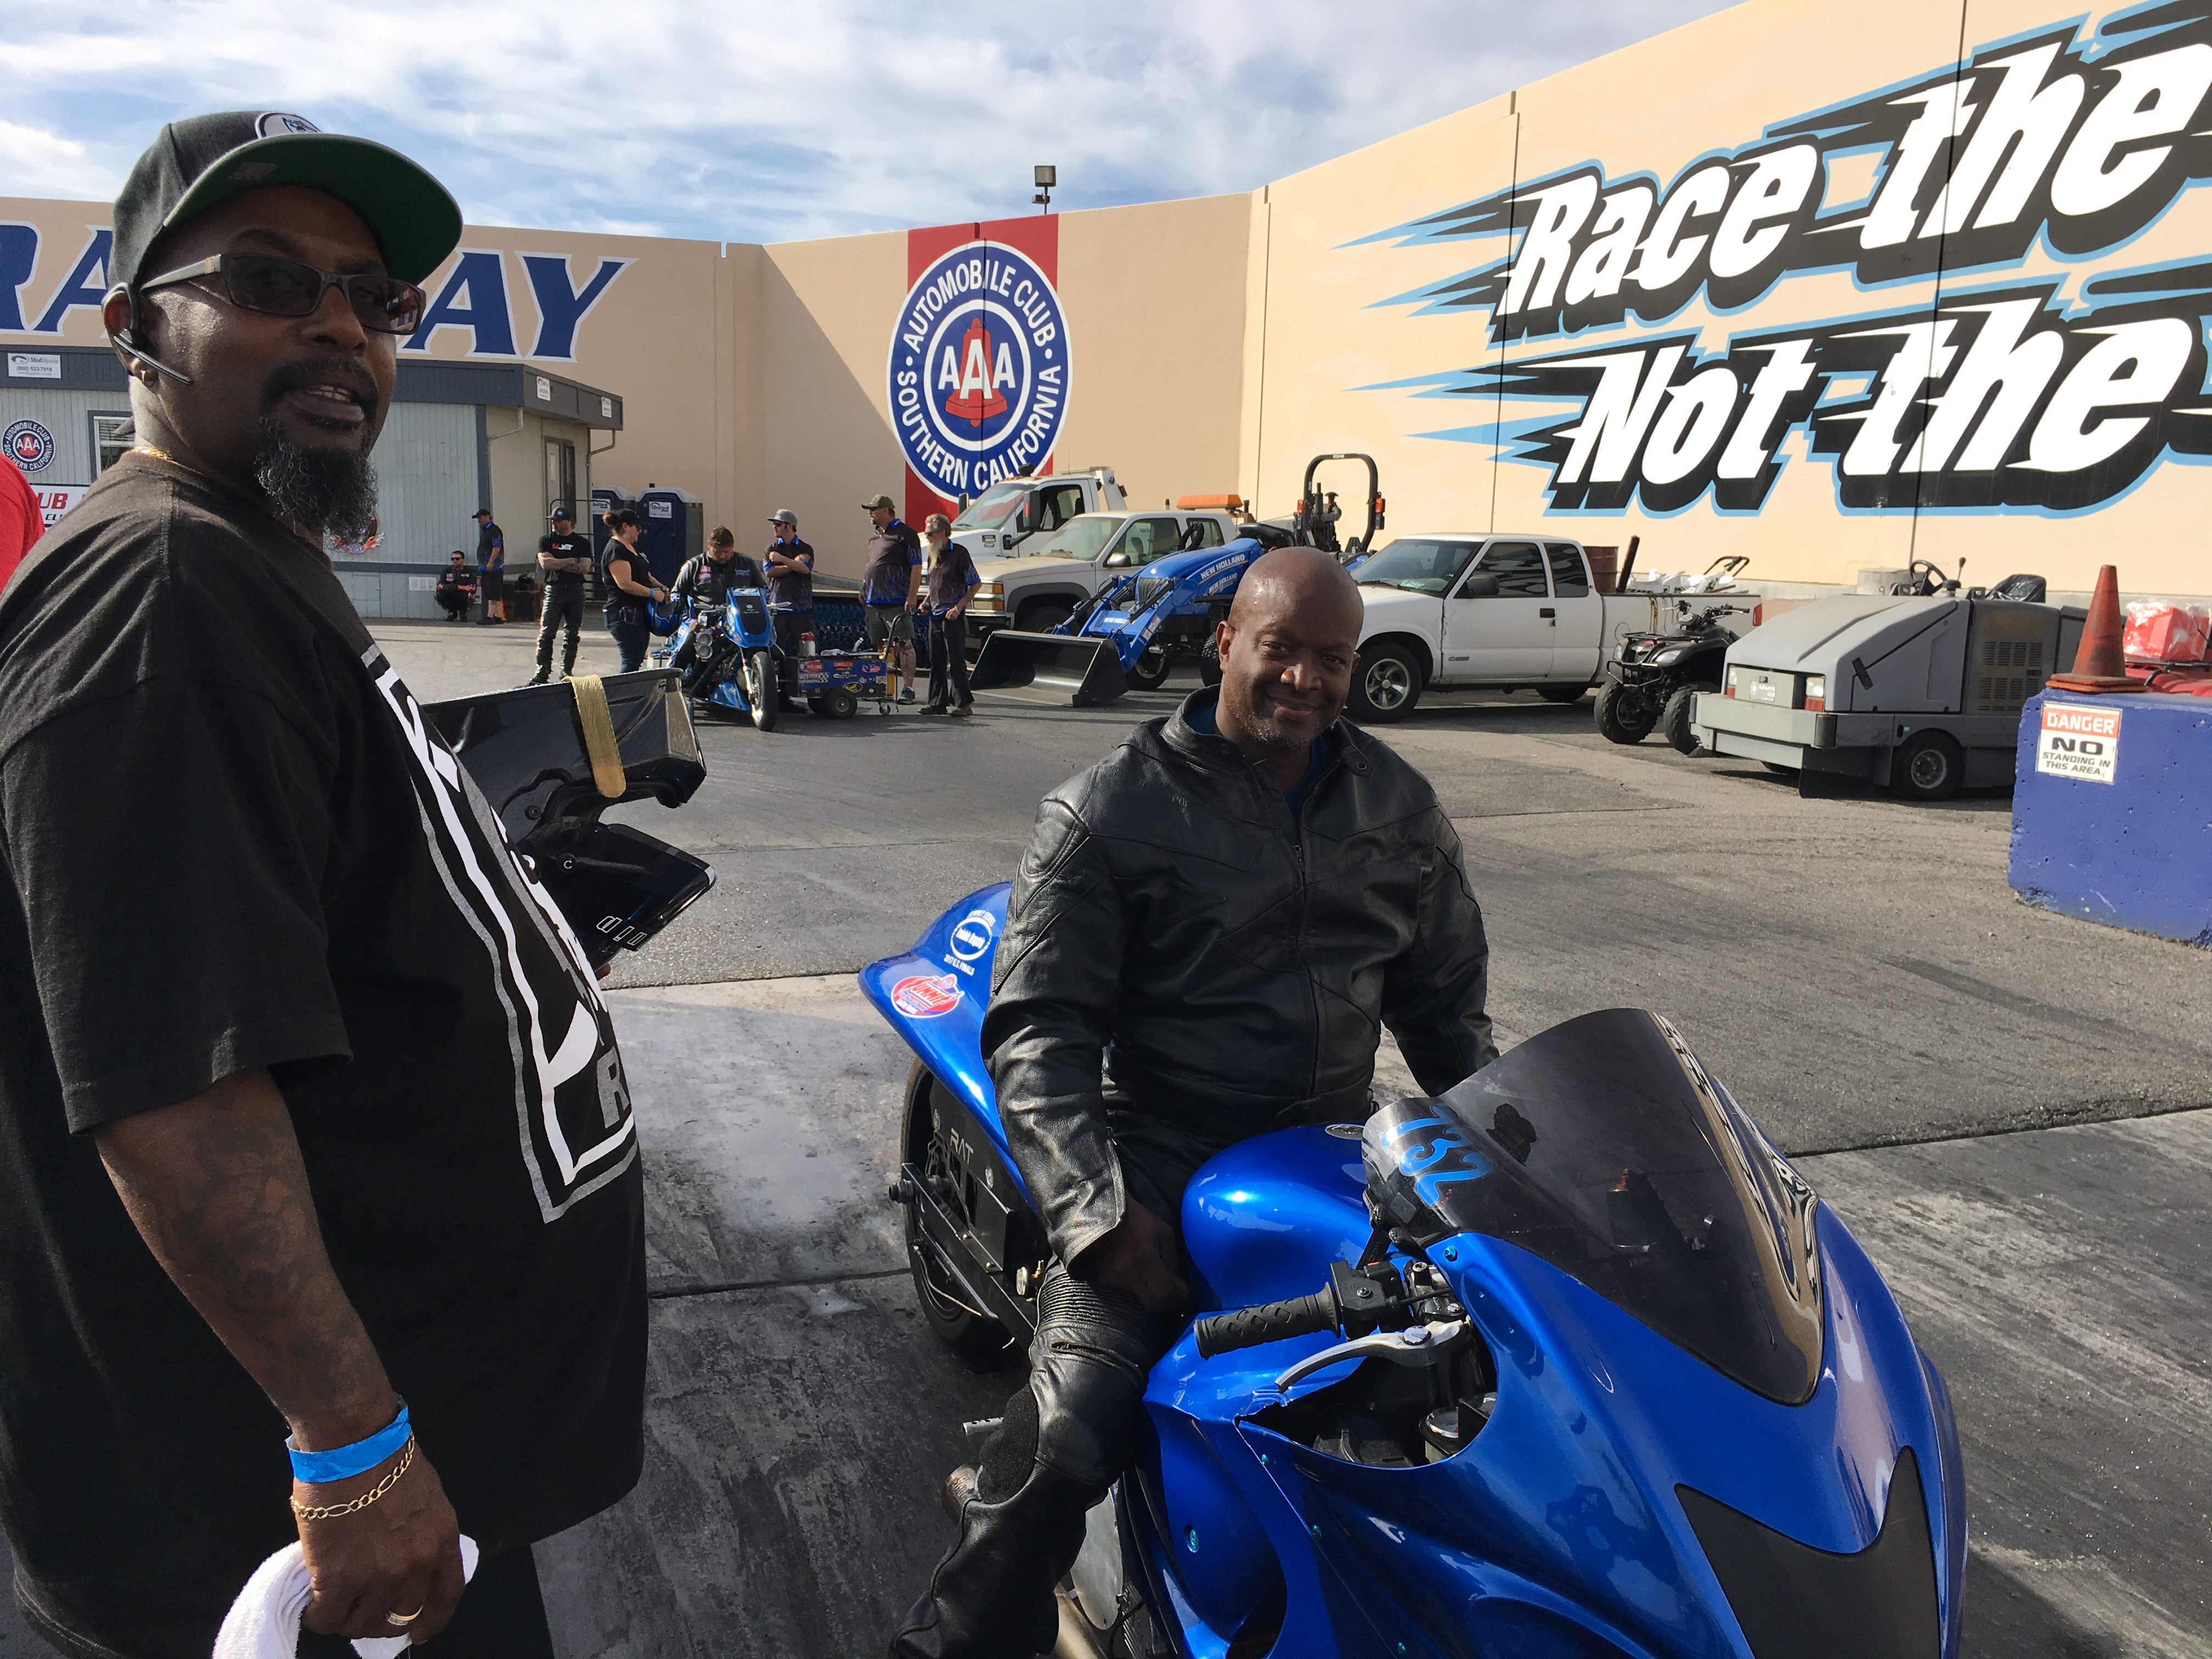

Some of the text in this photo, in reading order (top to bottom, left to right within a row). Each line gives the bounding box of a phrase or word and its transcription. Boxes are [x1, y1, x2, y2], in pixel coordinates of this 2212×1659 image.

[1497, 42, 2212, 317] Race the
[903, 259, 1056, 354] AUTOMOBILE CLUB
[938, 338, 1015, 400] AAA
[1528, 297, 2194, 486] Not the
[5, 422, 50, 442] AUTOMOBILE CLUB
[897, 364, 1061, 490] SOUTHERN CALIFORNIA
[16, 437, 41, 451] AAA
[29, 444, 53, 470] CALIFORNIA
[1200, 554, 1245, 580] NEW HOLLAND
[1209, 581, 1219, 594] NEW
[1218, 572, 1238, 586] HOLLAND
[2046, 712, 2115, 735] DANGER
[2051, 736, 2103, 756] NO
[2042, 752, 2111, 768] STANDING IN
[2046, 760, 2069, 770] THIS
